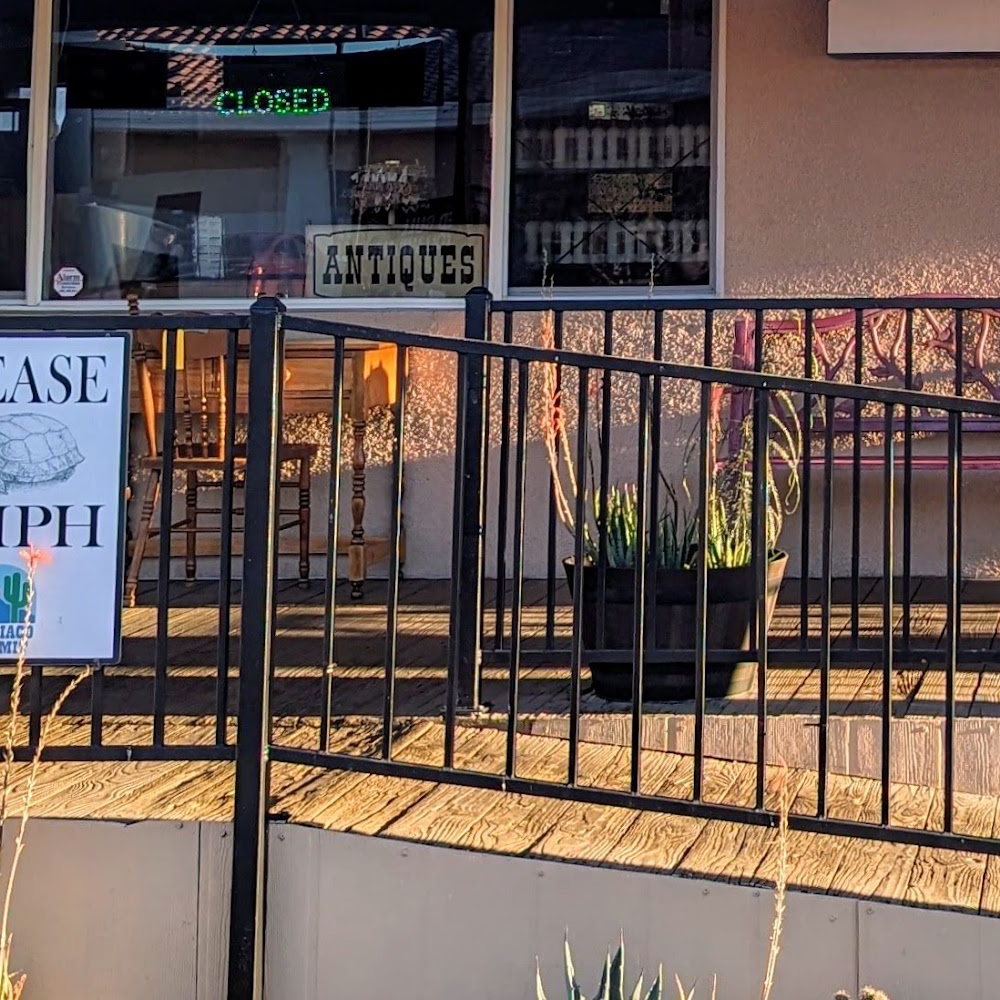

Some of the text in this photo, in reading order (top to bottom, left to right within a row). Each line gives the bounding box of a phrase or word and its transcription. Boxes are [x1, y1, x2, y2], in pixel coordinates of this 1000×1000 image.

[215, 88, 330, 116] CLOSED
[322, 245, 475, 292] ANTIQUES
[0, 354, 109, 405] ASE
[0, 504, 106, 548] PH
